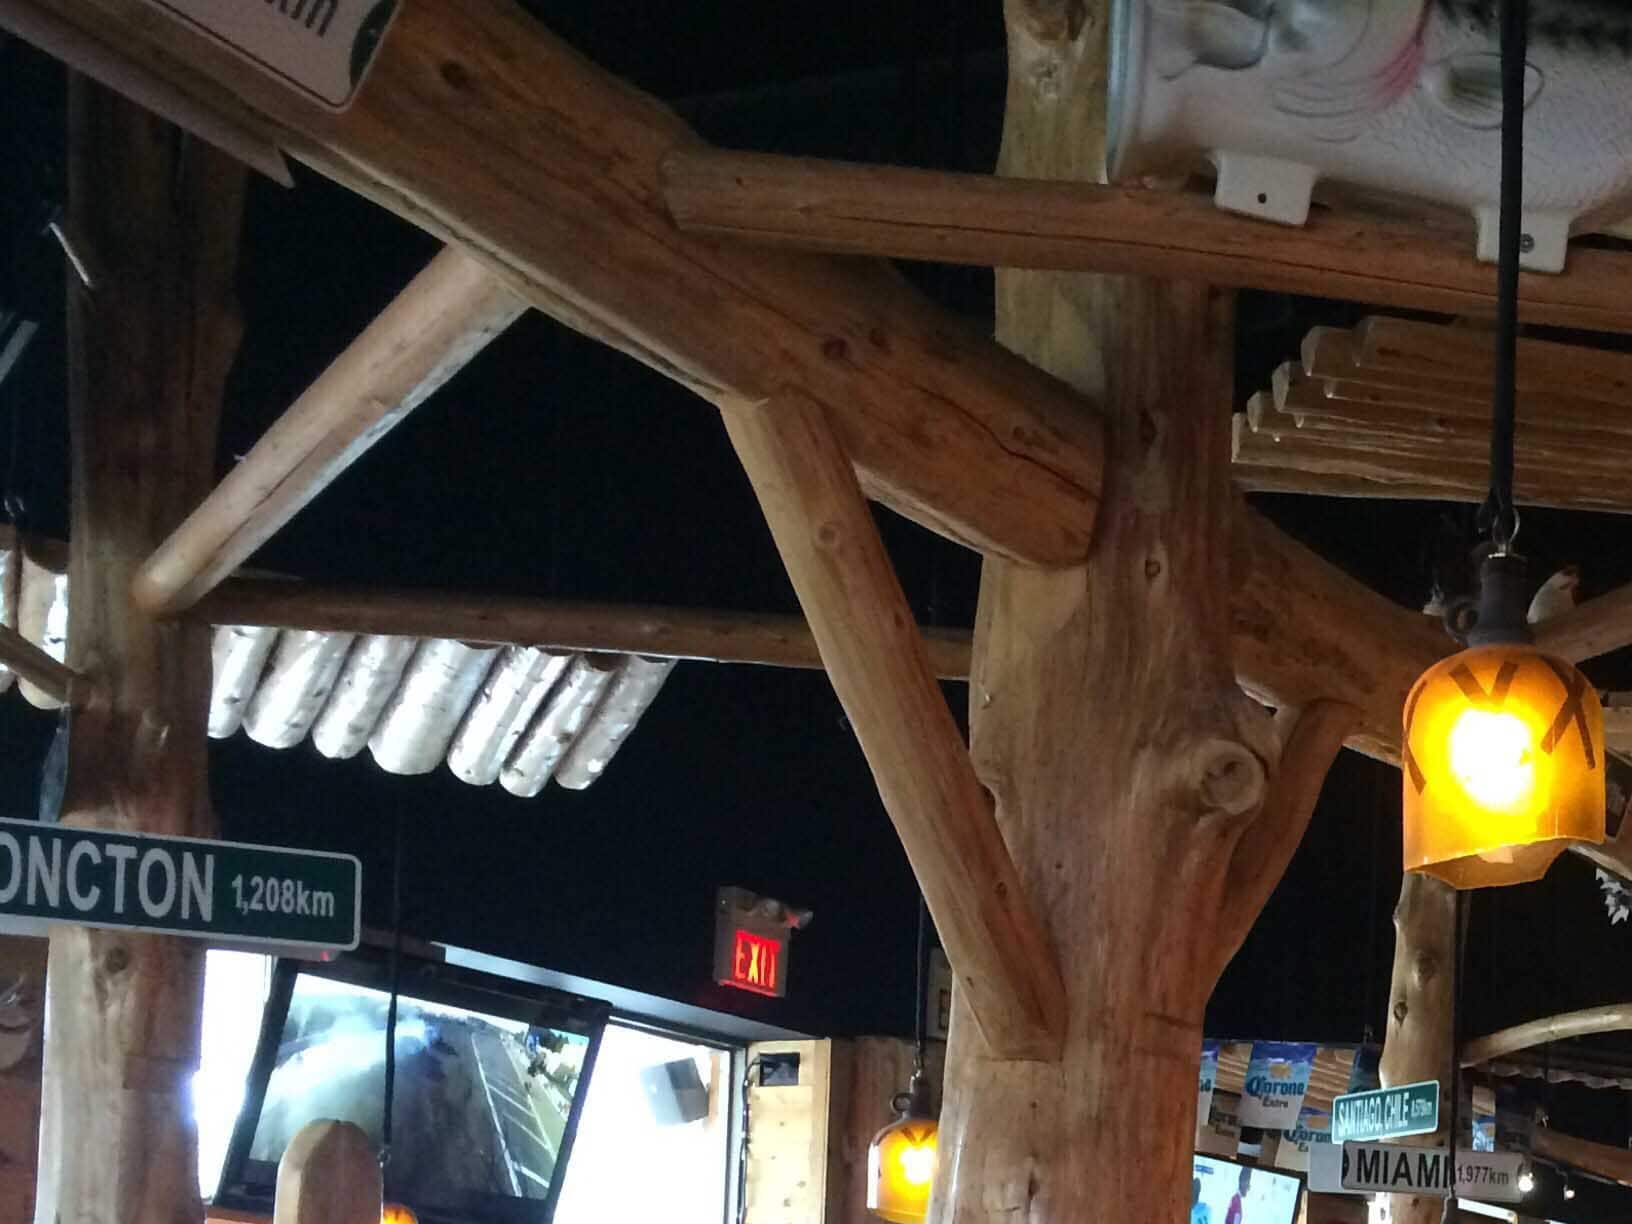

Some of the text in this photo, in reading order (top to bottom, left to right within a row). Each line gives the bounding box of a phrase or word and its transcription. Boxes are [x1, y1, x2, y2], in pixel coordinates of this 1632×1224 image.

[231, 874, 335, 918] 1,208km
[1246, 1075, 1304, 1099] Corona
[1384, 1091, 1410, 1130] CHILE
[1457, 1164, 1509, 1186] 1,977km
